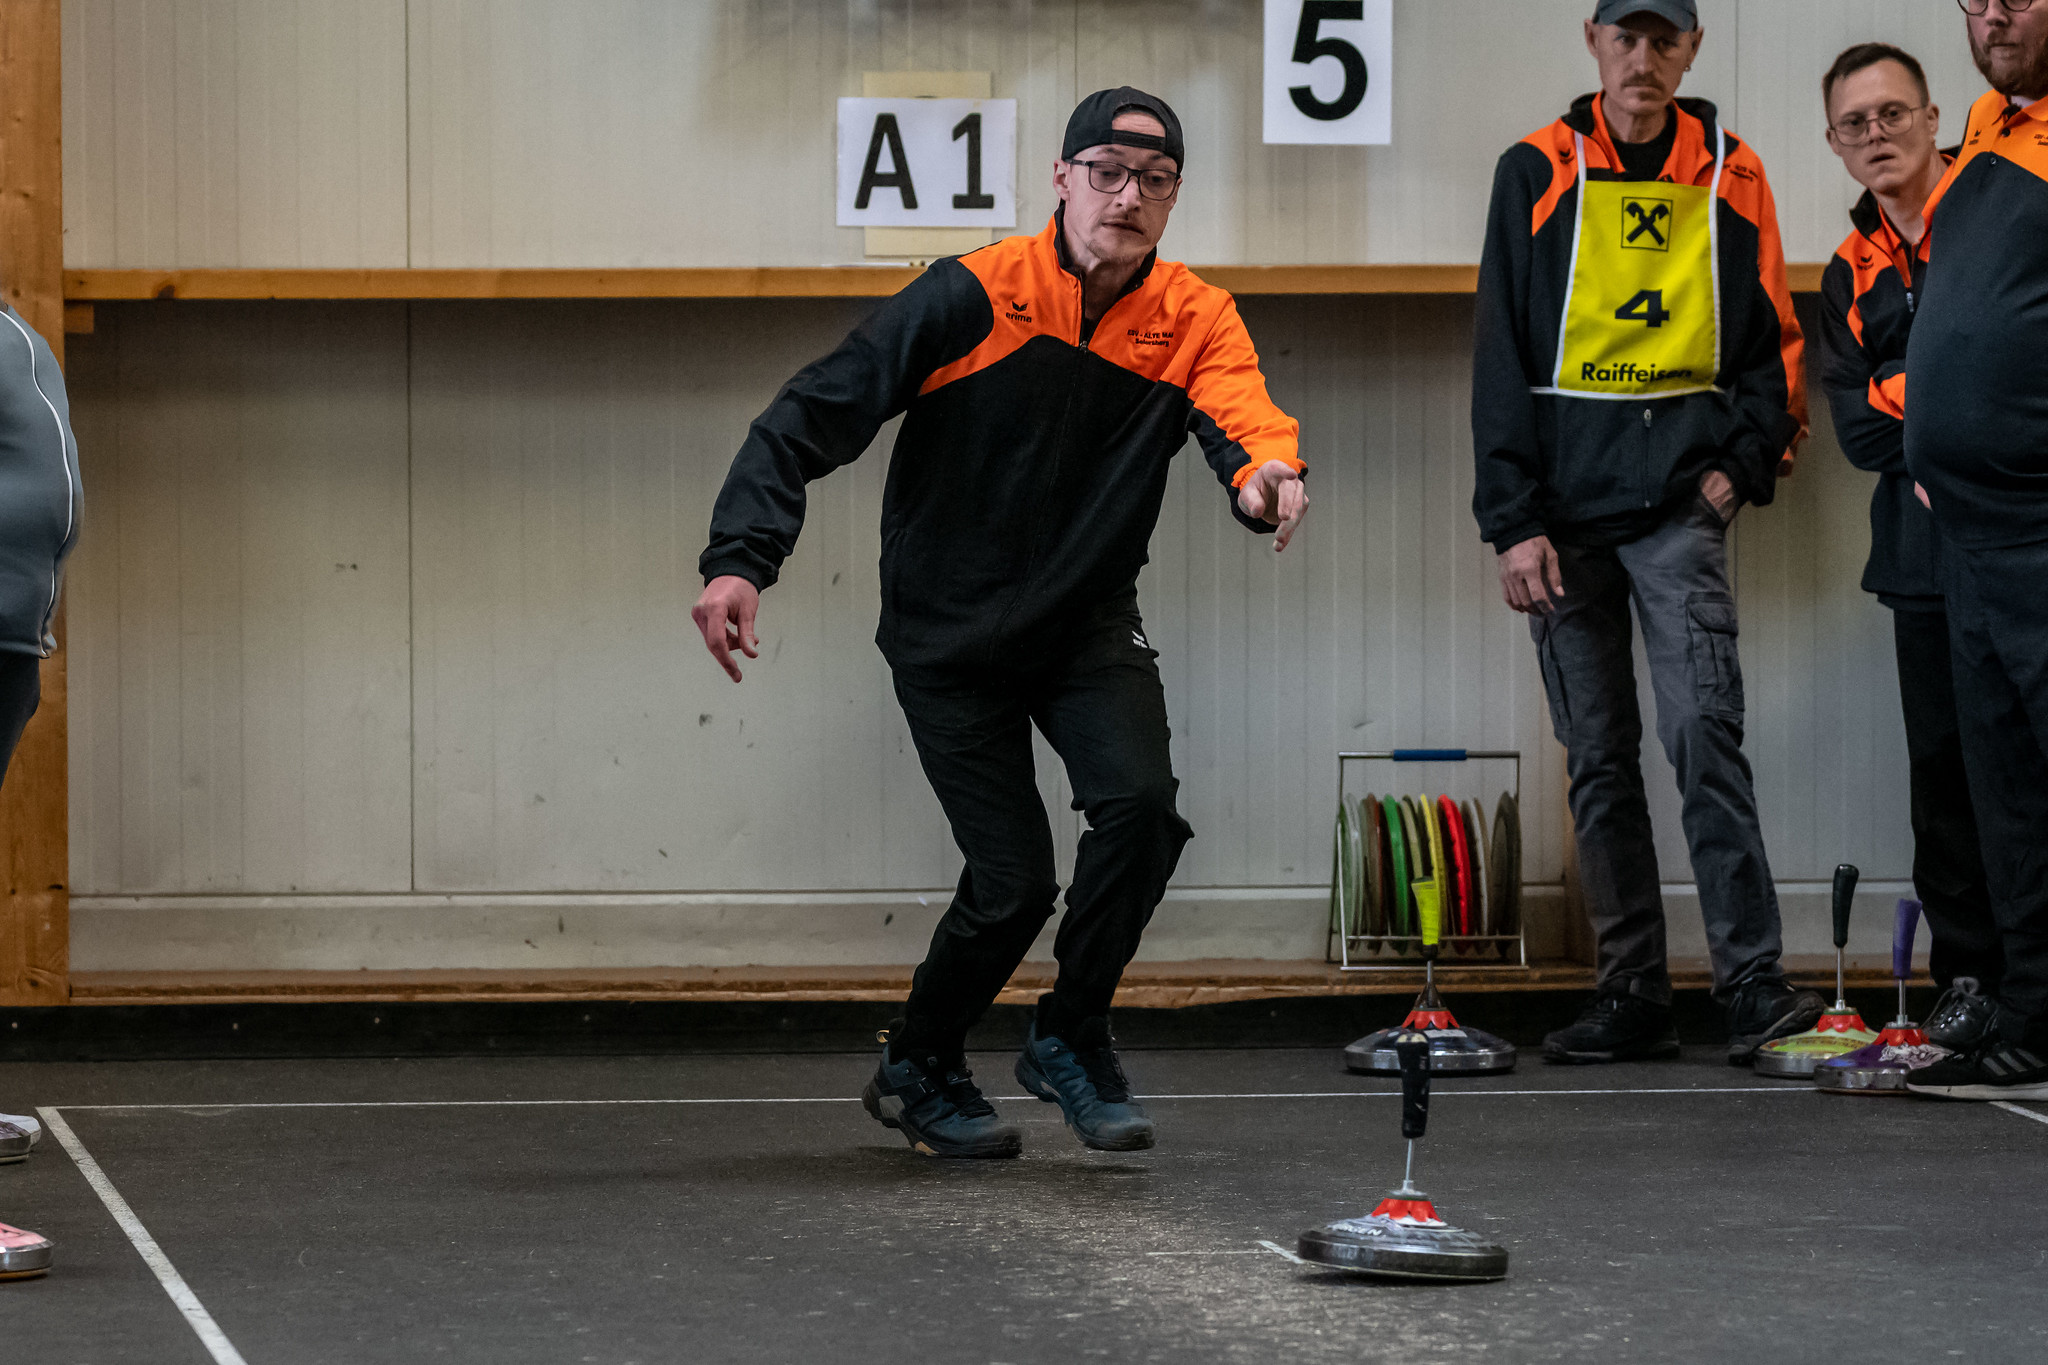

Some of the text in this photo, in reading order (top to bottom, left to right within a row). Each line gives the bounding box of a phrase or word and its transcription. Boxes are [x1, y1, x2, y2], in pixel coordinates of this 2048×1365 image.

[1289, 0, 1368, 122] 5
[855, 112, 995, 210] A 1
[1005, 312, 1032, 323] erima
[1614, 289, 1670, 329] 4
[1581, 362, 1693, 382] Raiffeisen
